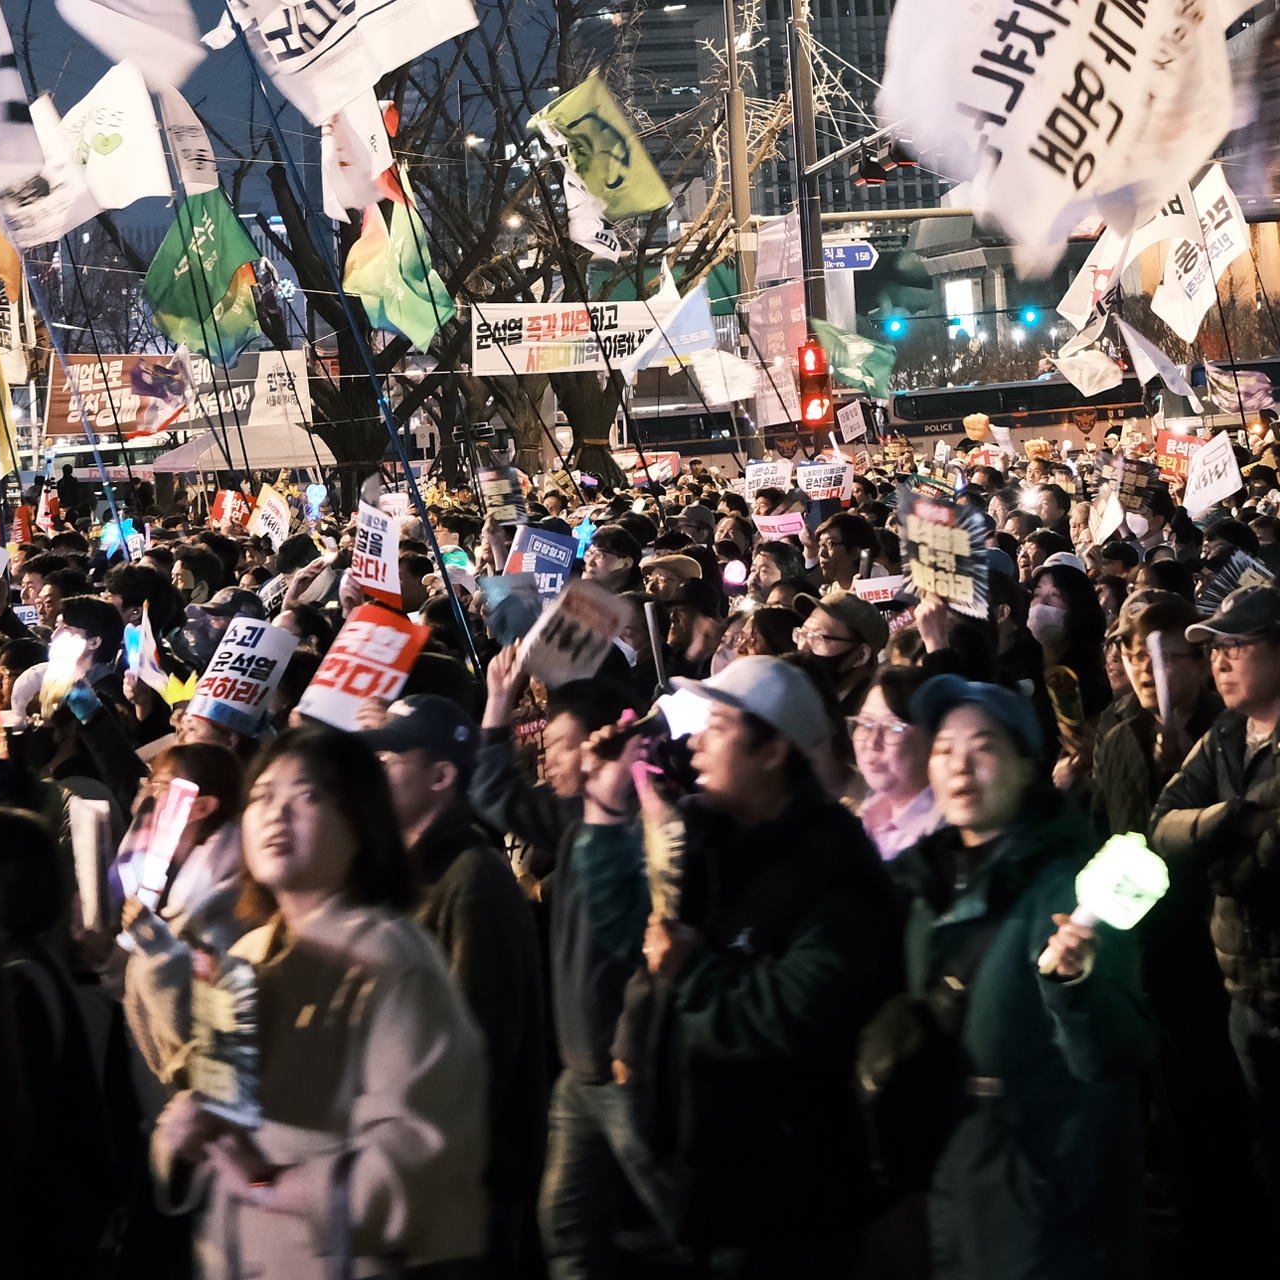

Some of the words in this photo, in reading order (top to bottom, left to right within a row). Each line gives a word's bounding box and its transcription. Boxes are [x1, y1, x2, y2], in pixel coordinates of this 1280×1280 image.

[823, 247, 846, 259] 직로
[855, 251, 870, 262] 158
[476, 317, 523, 350] 윤석열
[526, 314, 556, 341] 즉각
[561, 304, 618, 336] 파면하고
[924, 423, 953, 433] POLICE
[211, 651, 277, 682] 윤석열
